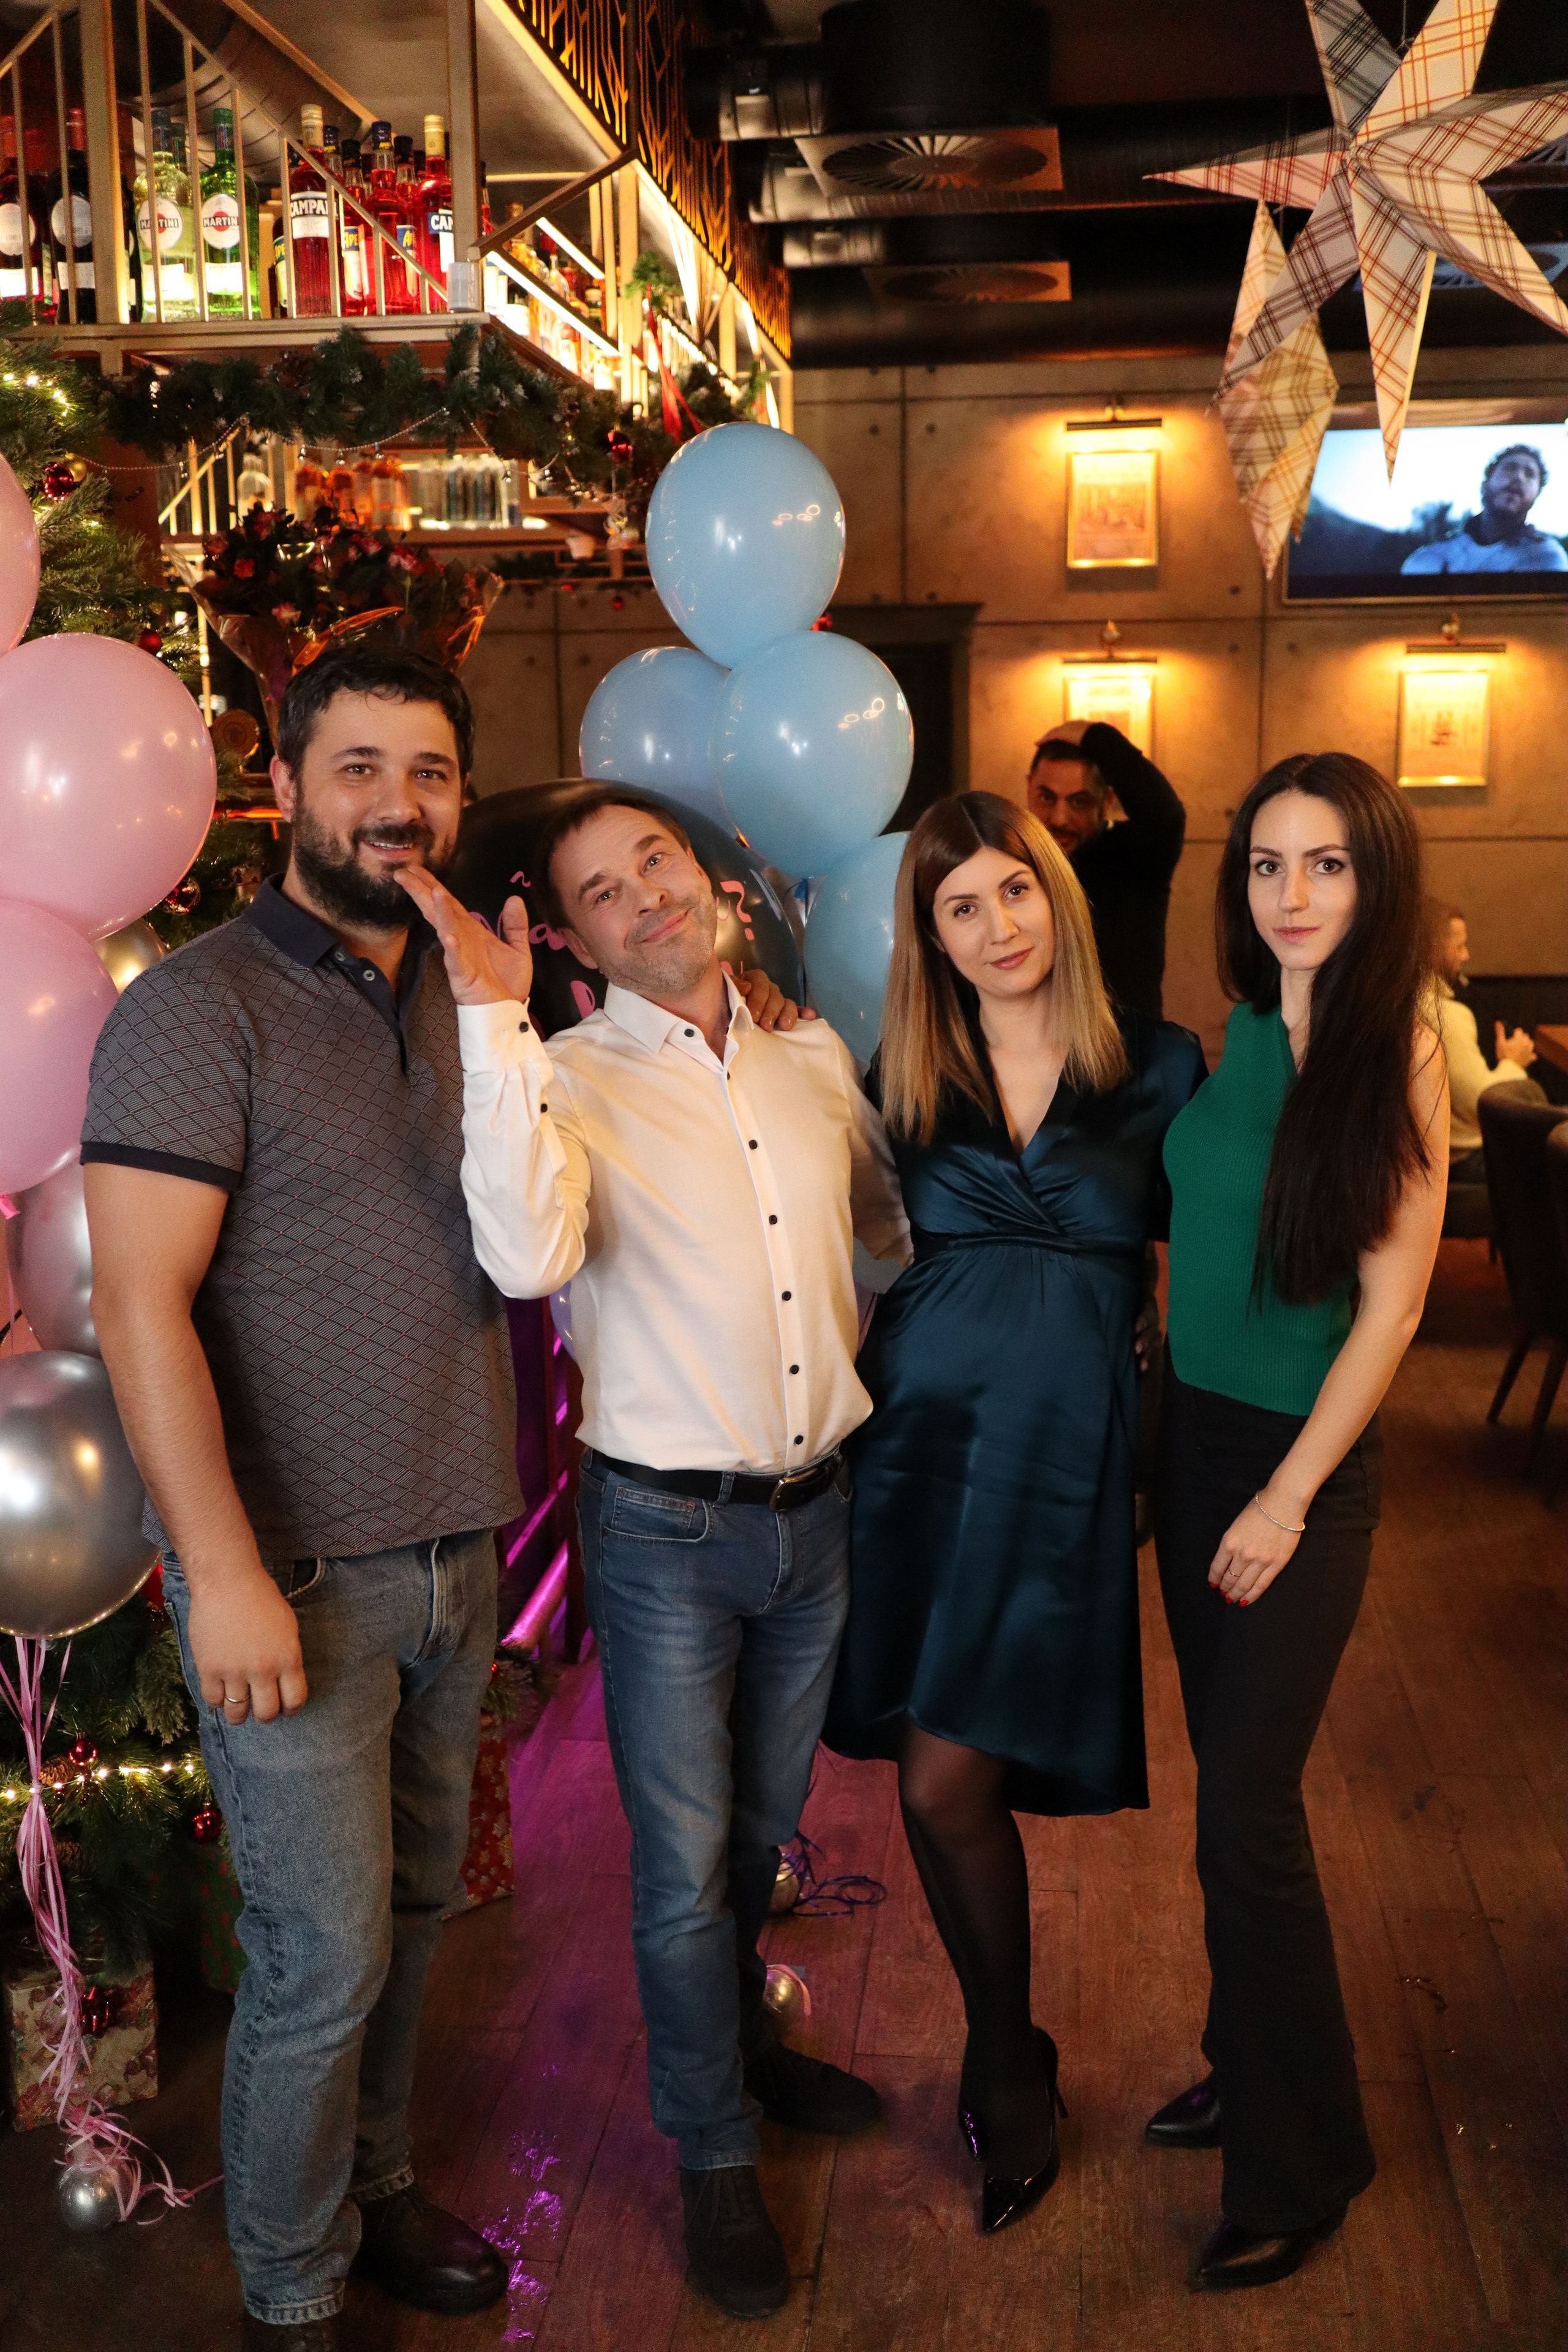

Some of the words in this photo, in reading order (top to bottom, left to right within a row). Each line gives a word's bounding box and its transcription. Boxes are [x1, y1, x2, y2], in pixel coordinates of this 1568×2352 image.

[290, 199, 338, 218] CAMPAI
[140, 218, 179, 230] MATINI
[203, 216, 238, 227] MARTIN
